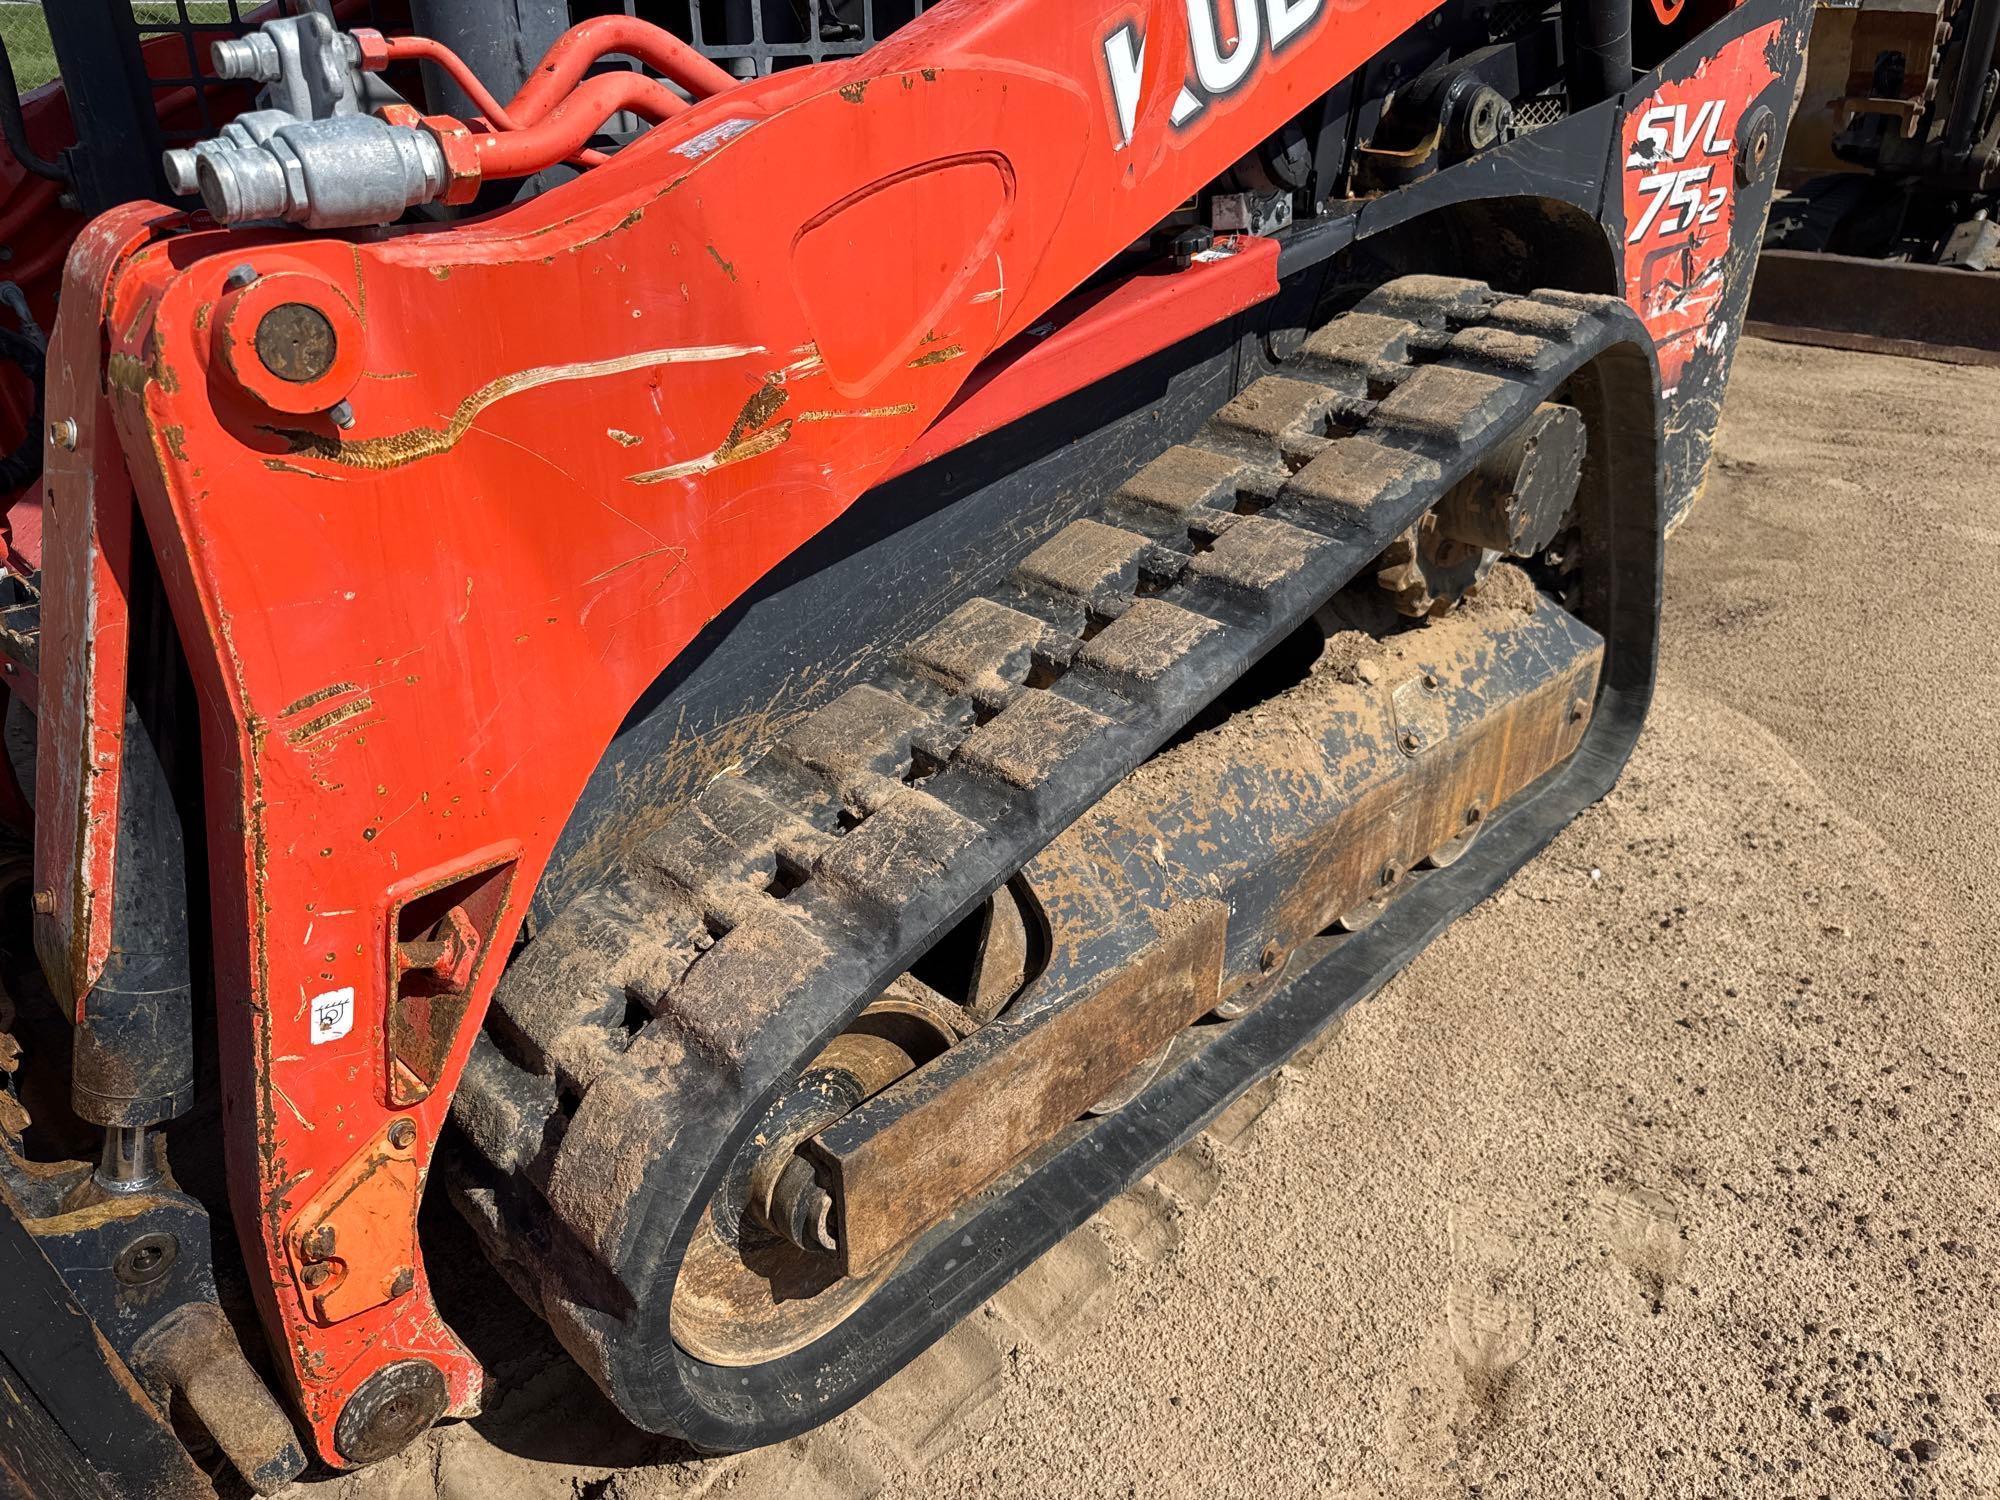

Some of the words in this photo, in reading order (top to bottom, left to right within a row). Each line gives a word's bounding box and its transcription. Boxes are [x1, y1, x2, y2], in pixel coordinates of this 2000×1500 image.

[1104, 0, 1322, 151] KU
[1626, 100, 1733, 171] SVL
[1627, 165, 1728, 245] 75-2
